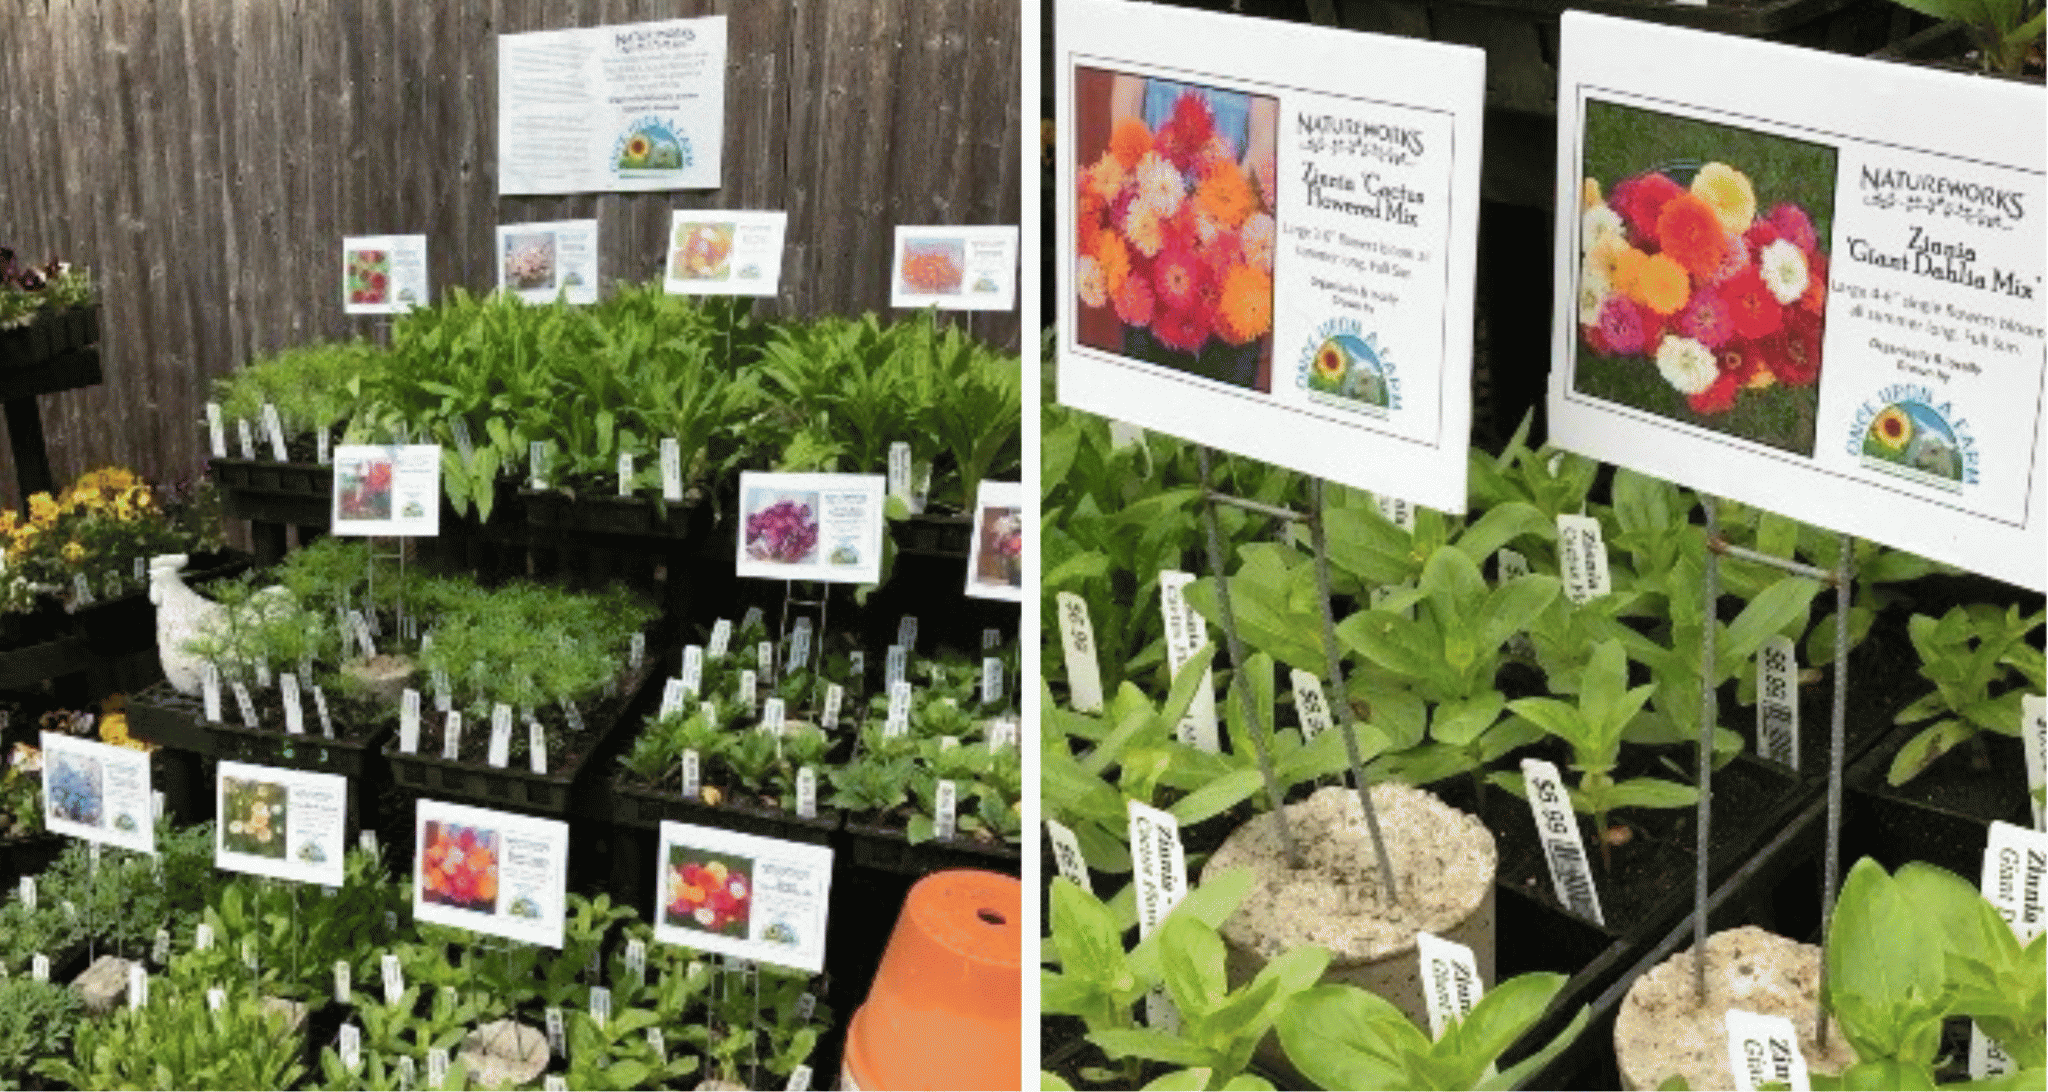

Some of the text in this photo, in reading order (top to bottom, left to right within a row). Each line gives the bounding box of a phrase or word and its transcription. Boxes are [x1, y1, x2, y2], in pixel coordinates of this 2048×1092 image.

[1298, 111, 1425, 157] NATUREWORKS
[1307, 182, 1380, 219] Flowered
[1860, 164, 2026, 221] NATUREWORKS
[1908, 225, 1977, 263] Zinnia
[1913, 249, 1986, 290] Dahlia
[1157, 823, 1176, 892] Zinnia
